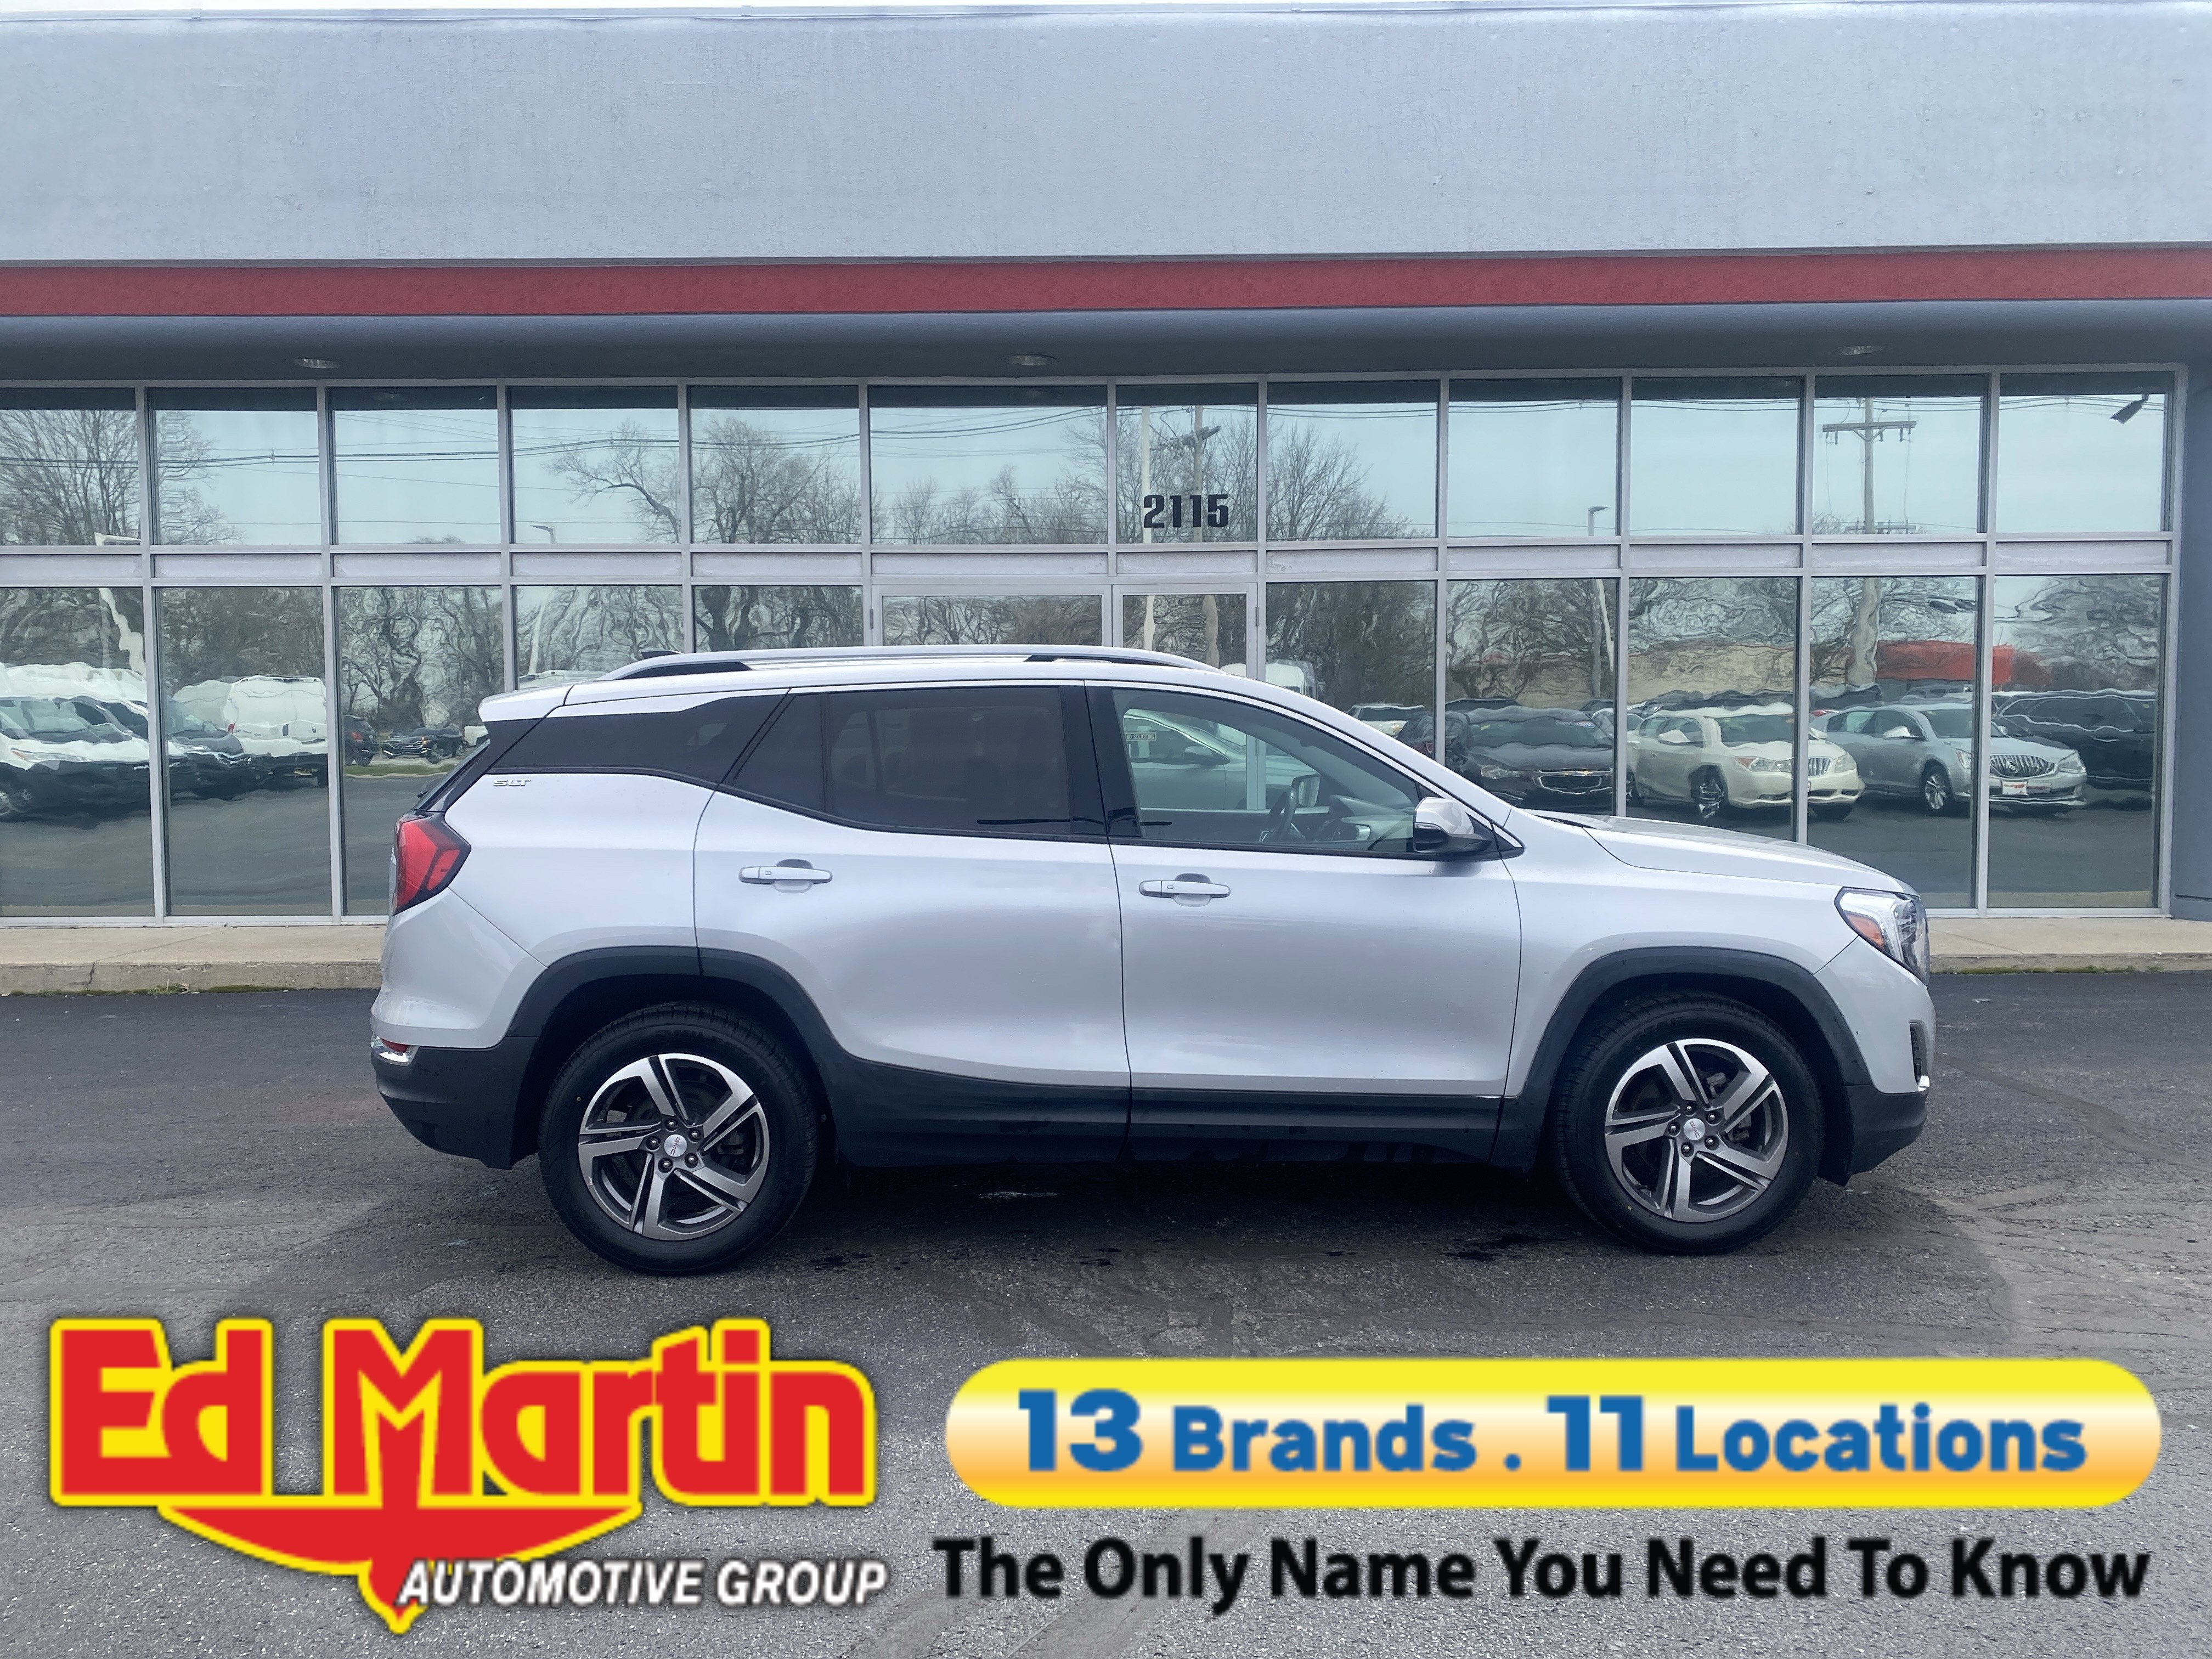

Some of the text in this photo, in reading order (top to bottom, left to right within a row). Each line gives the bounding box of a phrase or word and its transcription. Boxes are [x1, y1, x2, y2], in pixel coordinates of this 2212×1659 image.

[1143, 494, 1228, 528] 2115
[1690, 1121, 1700, 1138] GMC
[670, 1137, 680, 1155] GMC
